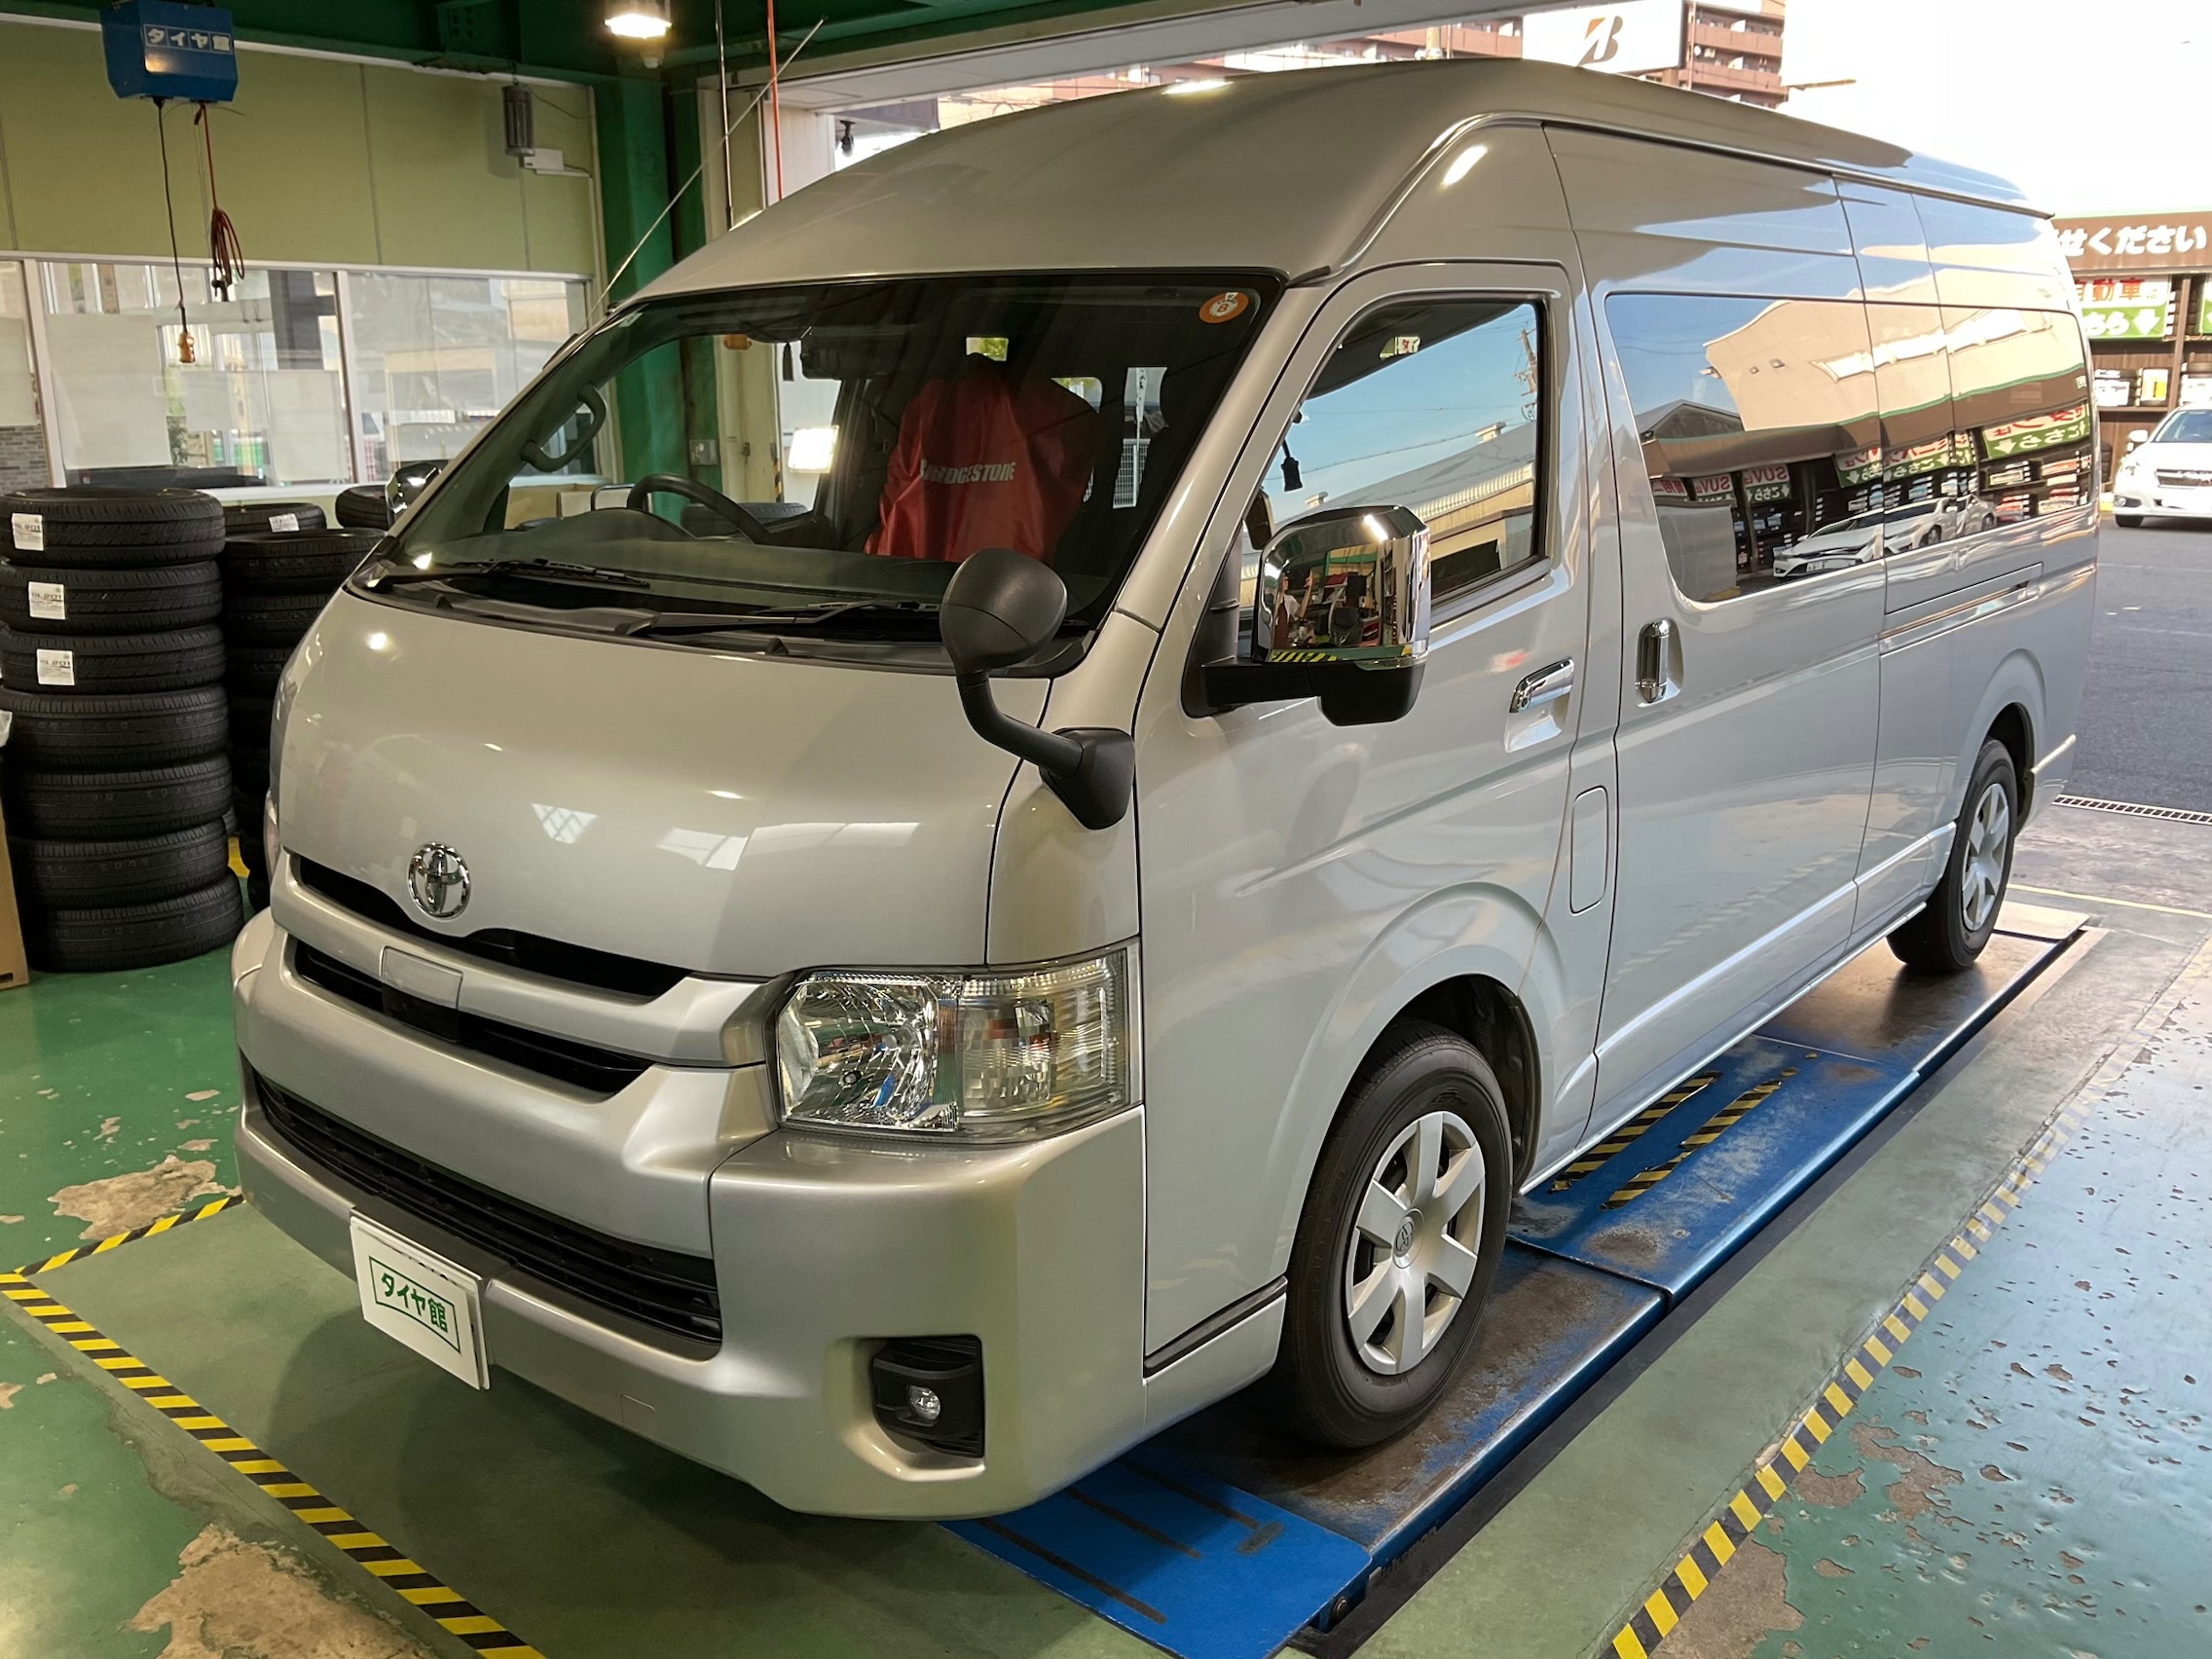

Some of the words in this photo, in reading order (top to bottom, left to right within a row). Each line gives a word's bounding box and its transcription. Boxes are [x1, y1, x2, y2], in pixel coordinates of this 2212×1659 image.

[2050, 225, 2207, 257] せください
[2082, 311, 2130, 336] ちら
[381, 1272, 448, 1333] タイヤ館
